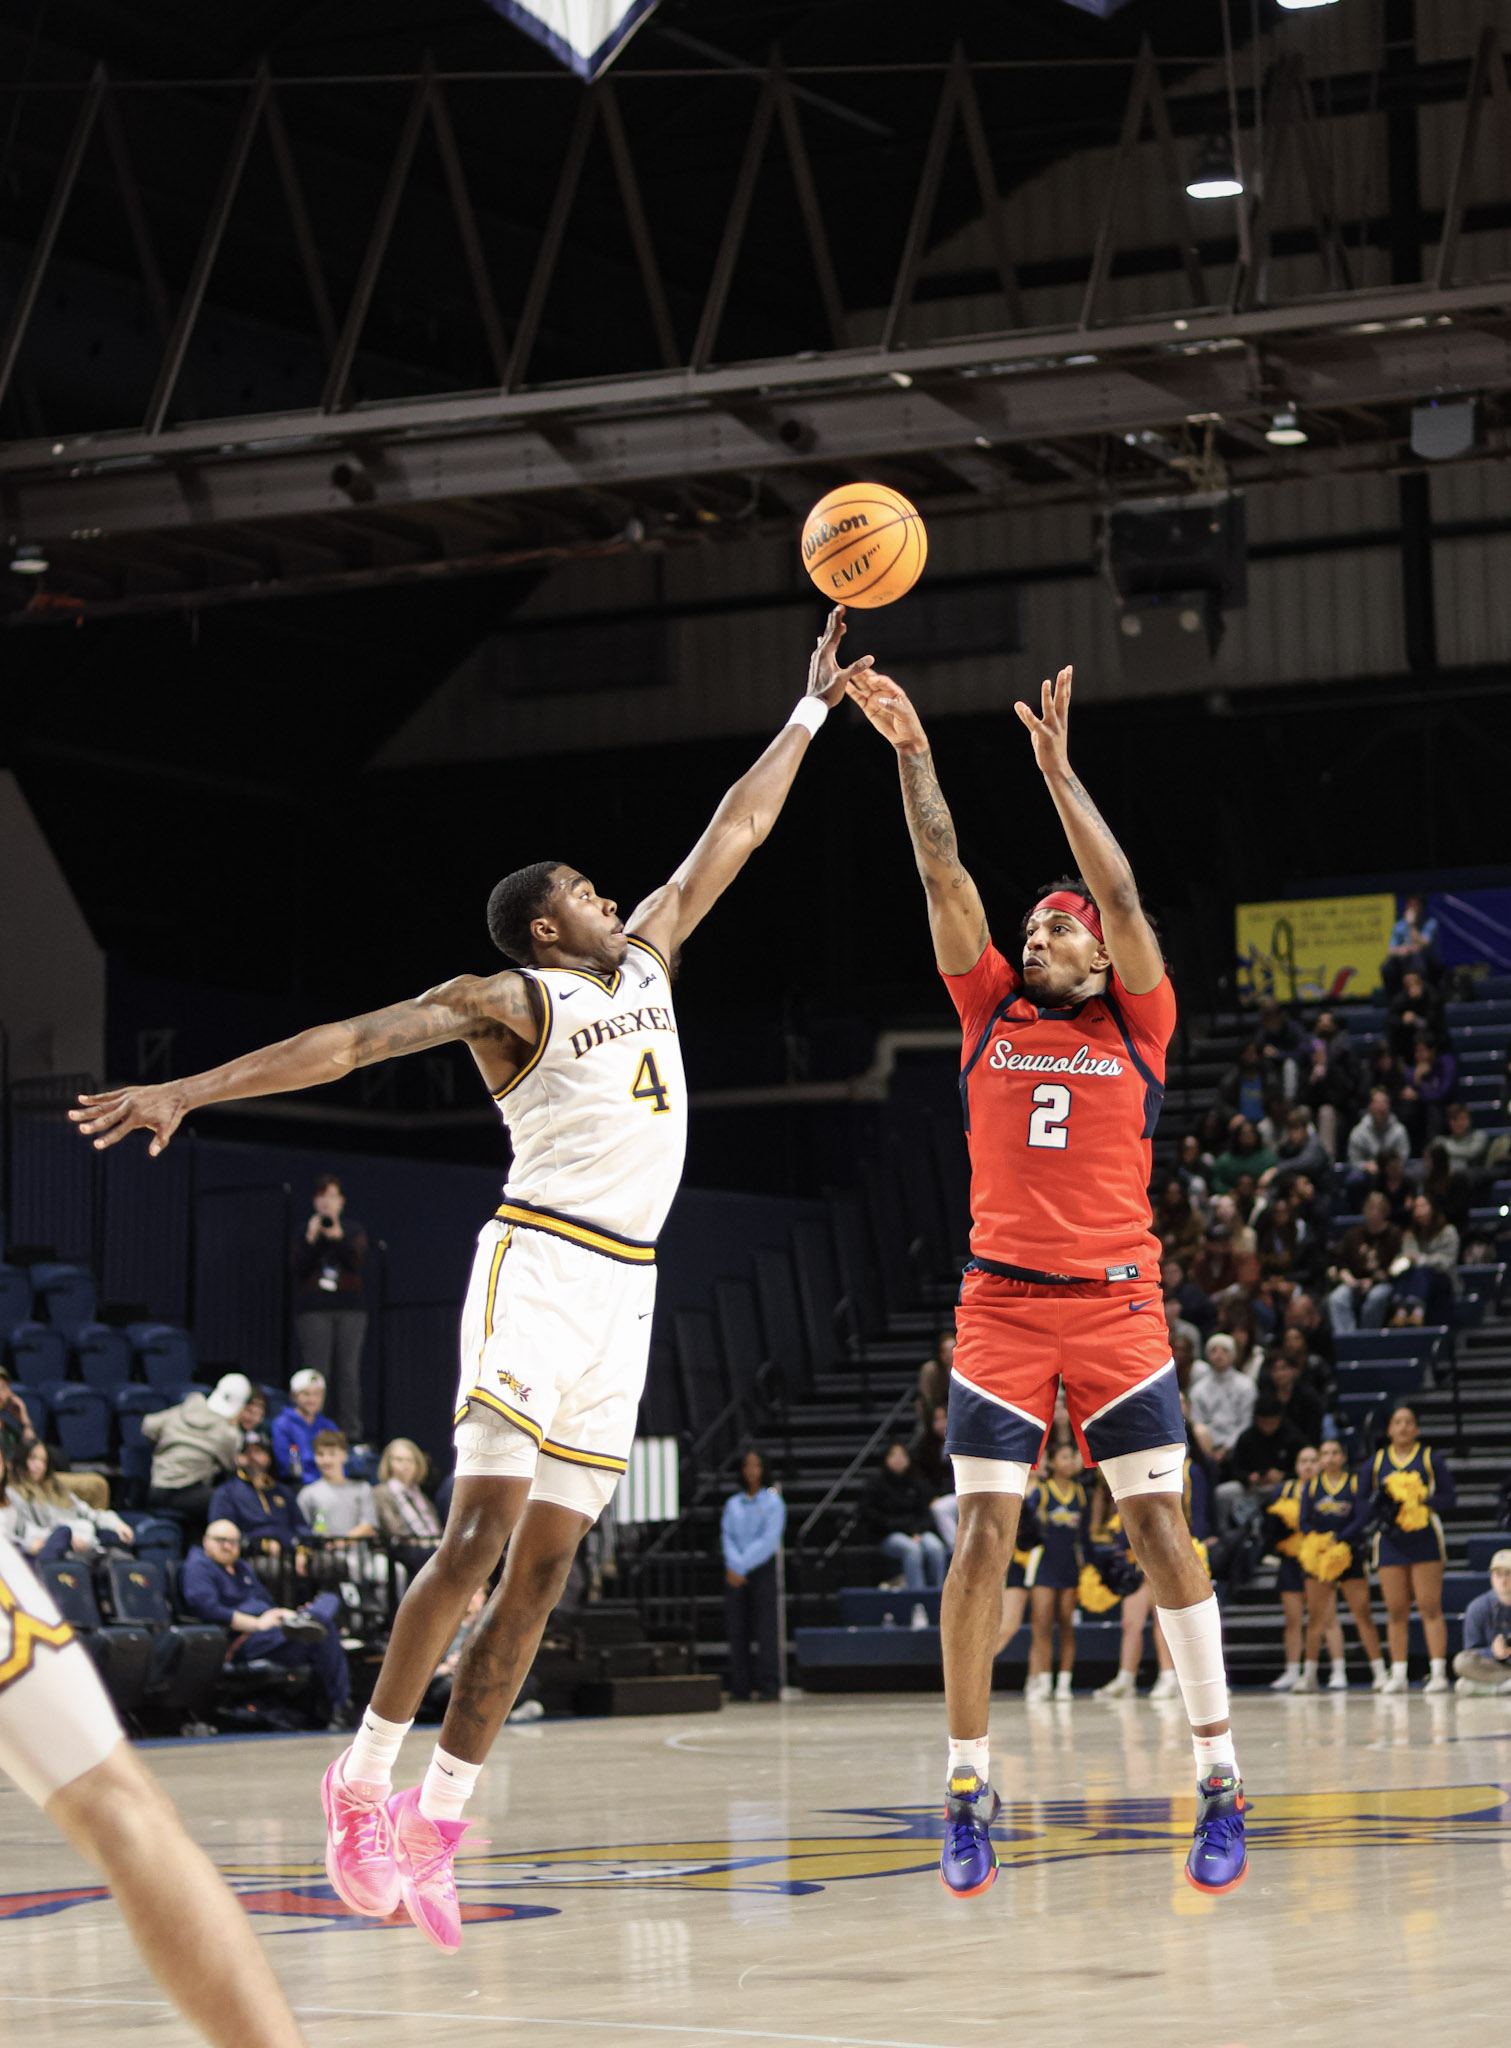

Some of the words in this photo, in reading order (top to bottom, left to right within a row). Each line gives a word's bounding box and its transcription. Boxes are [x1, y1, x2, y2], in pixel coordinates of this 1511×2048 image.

[803, 513, 869, 561] Wilson
[568, 1006, 676, 1060] DREXEL
[989, 1039, 1123, 1077] Seawolves
[630, 1048, 671, 1115] 4
[1027, 1083, 1072, 1150] 2
